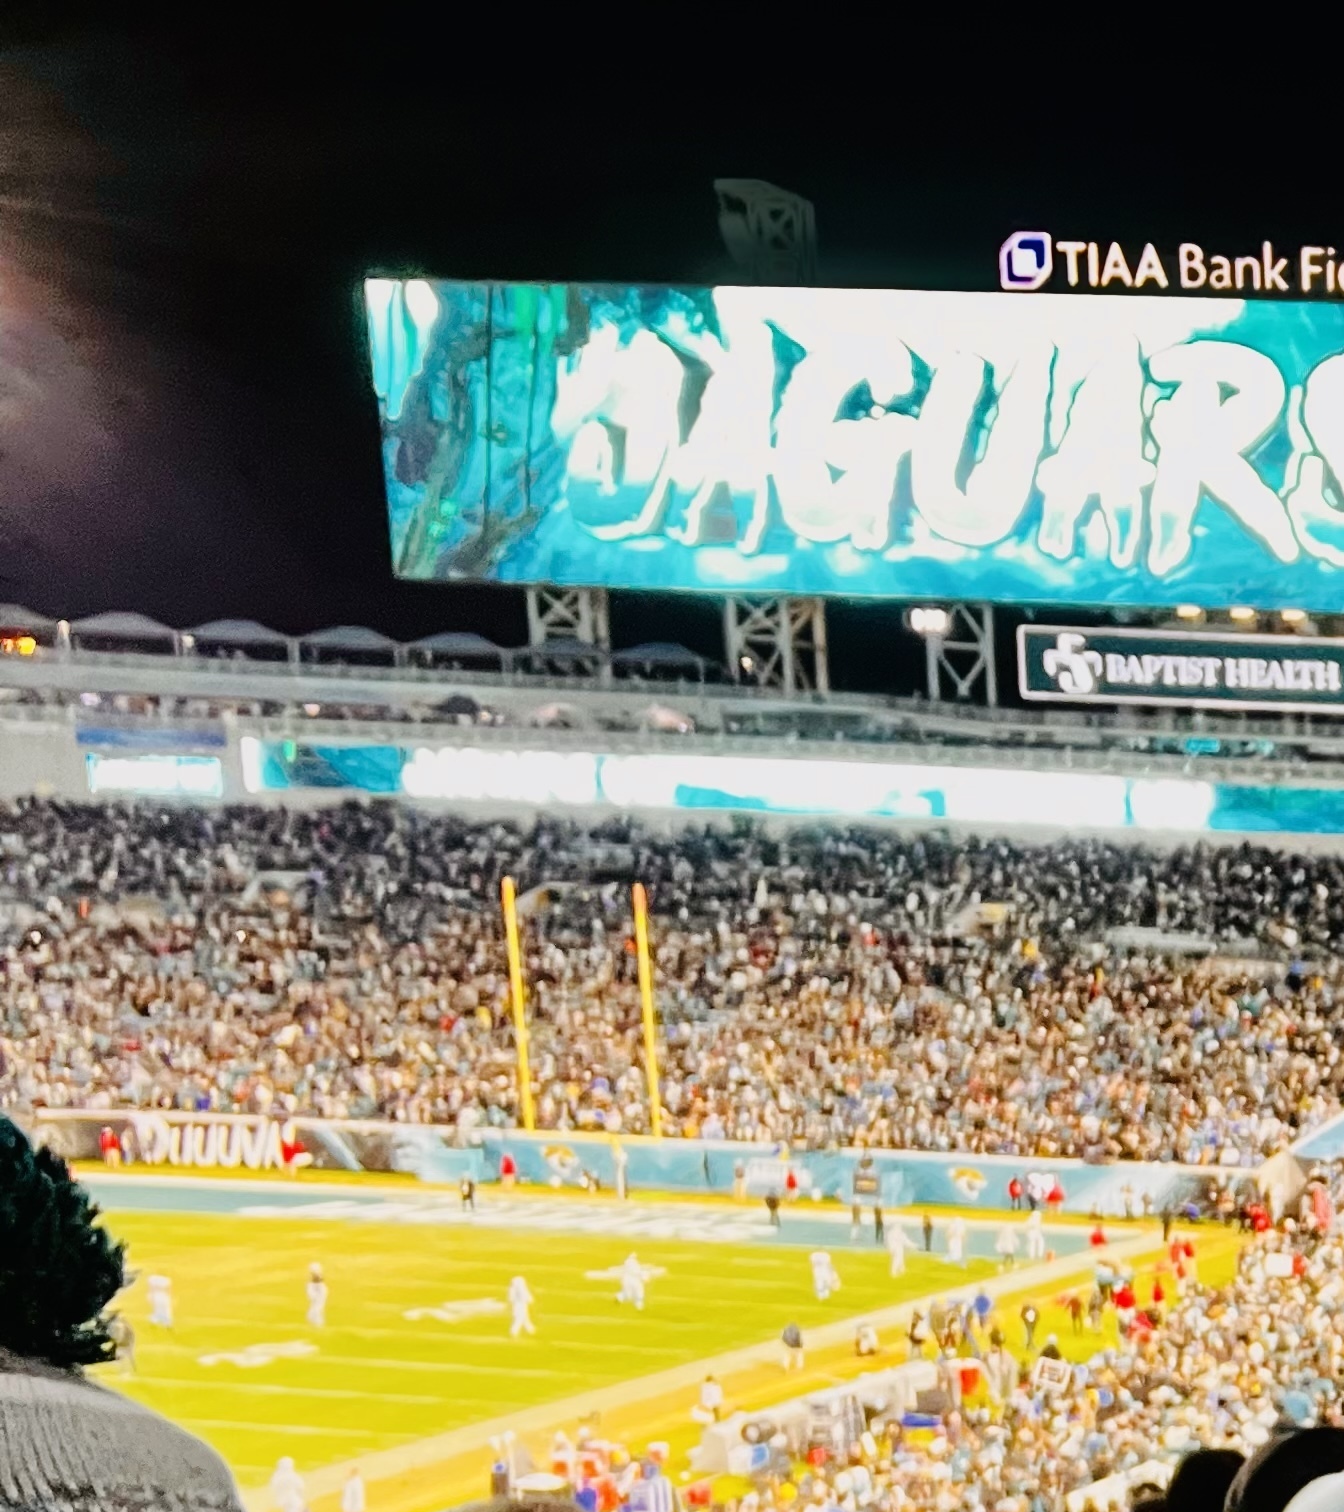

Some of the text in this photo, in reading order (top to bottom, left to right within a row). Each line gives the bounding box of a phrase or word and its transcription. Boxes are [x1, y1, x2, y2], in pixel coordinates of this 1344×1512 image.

[1056, 241, 1169, 288] TIAA
[1179, 241, 1290, 291] Bank
[1105, 653, 1342, 691] BAPTIST HEALTH
